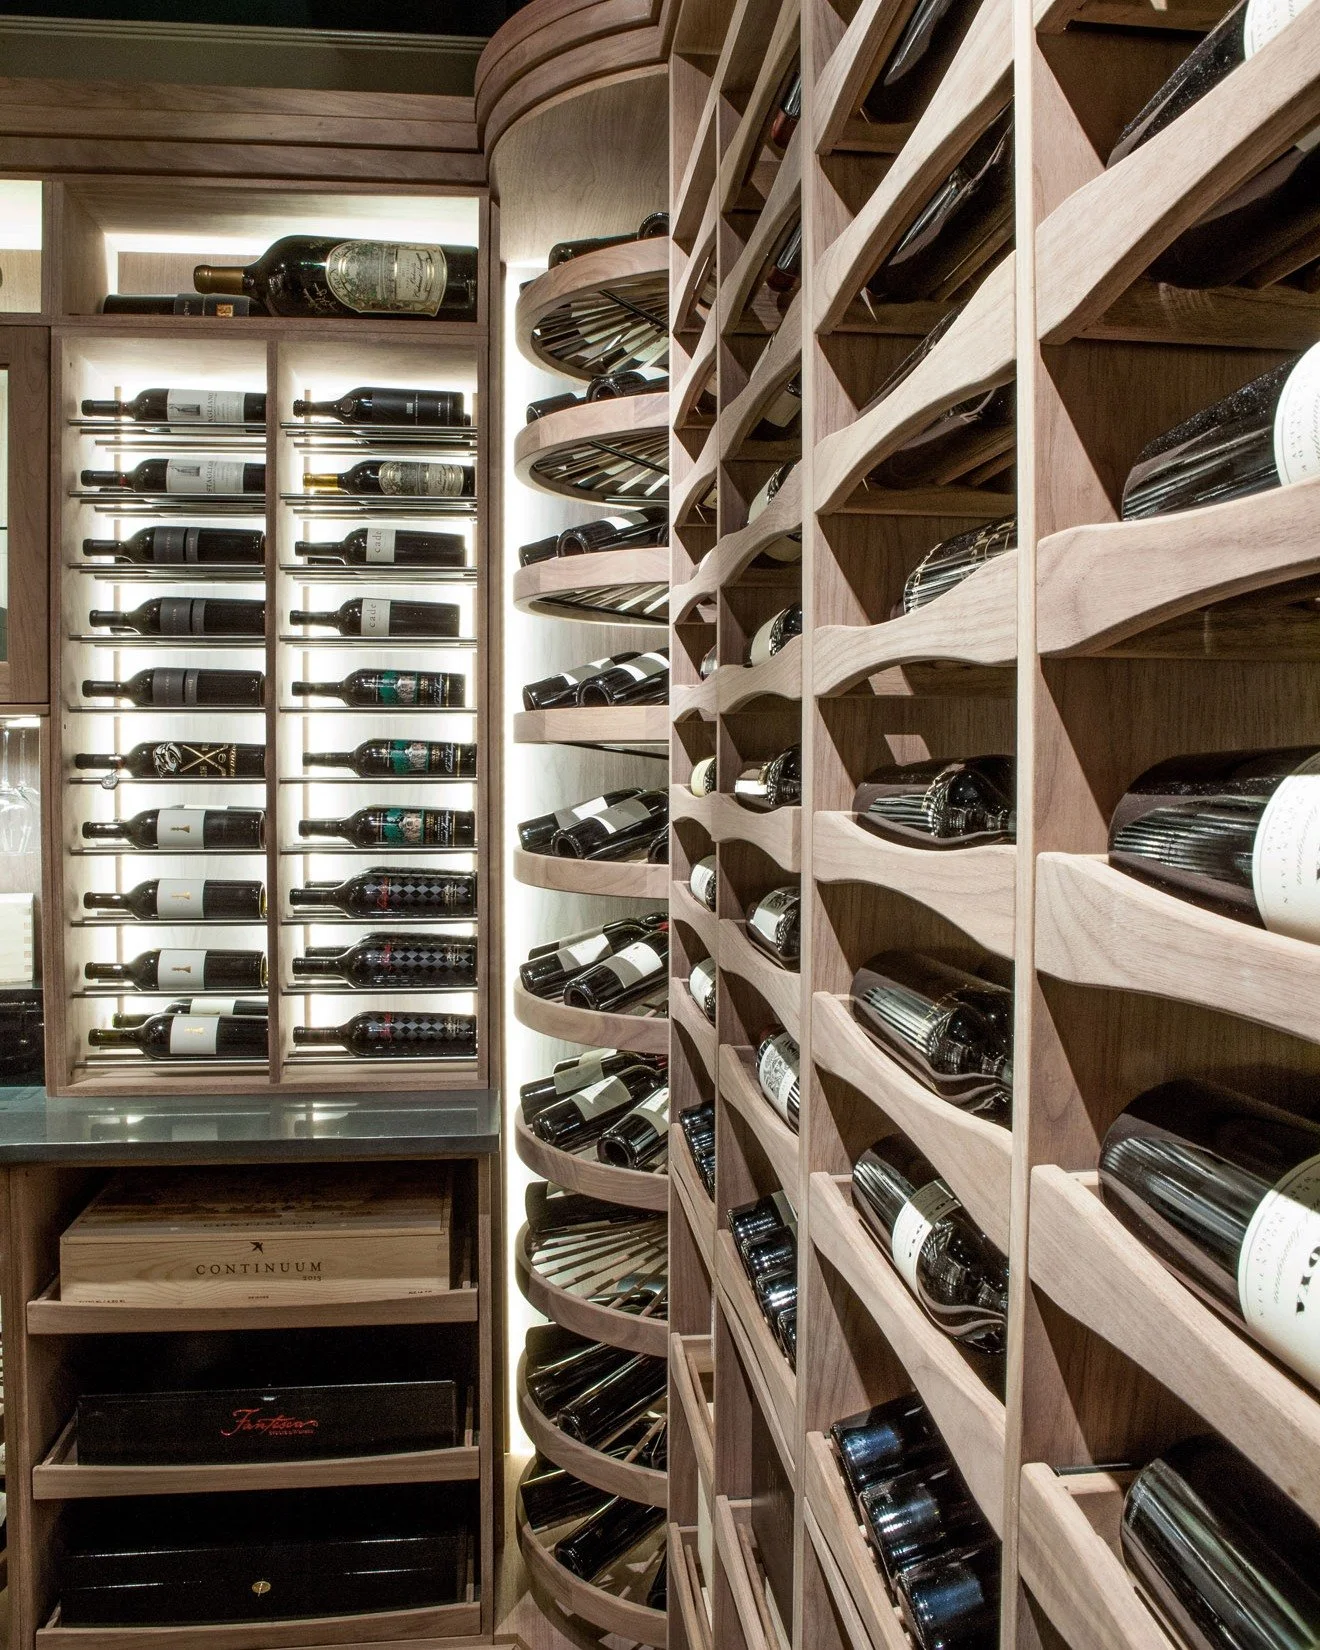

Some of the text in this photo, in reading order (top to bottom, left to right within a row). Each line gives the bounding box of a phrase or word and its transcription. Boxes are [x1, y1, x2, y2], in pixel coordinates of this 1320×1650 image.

[372, 530, 382, 554] cade
[366, 603, 377, 628] cade
[195, 1261, 322, 1276] CONTINUUM
[220, 1407, 319, 1436] Fantesca
